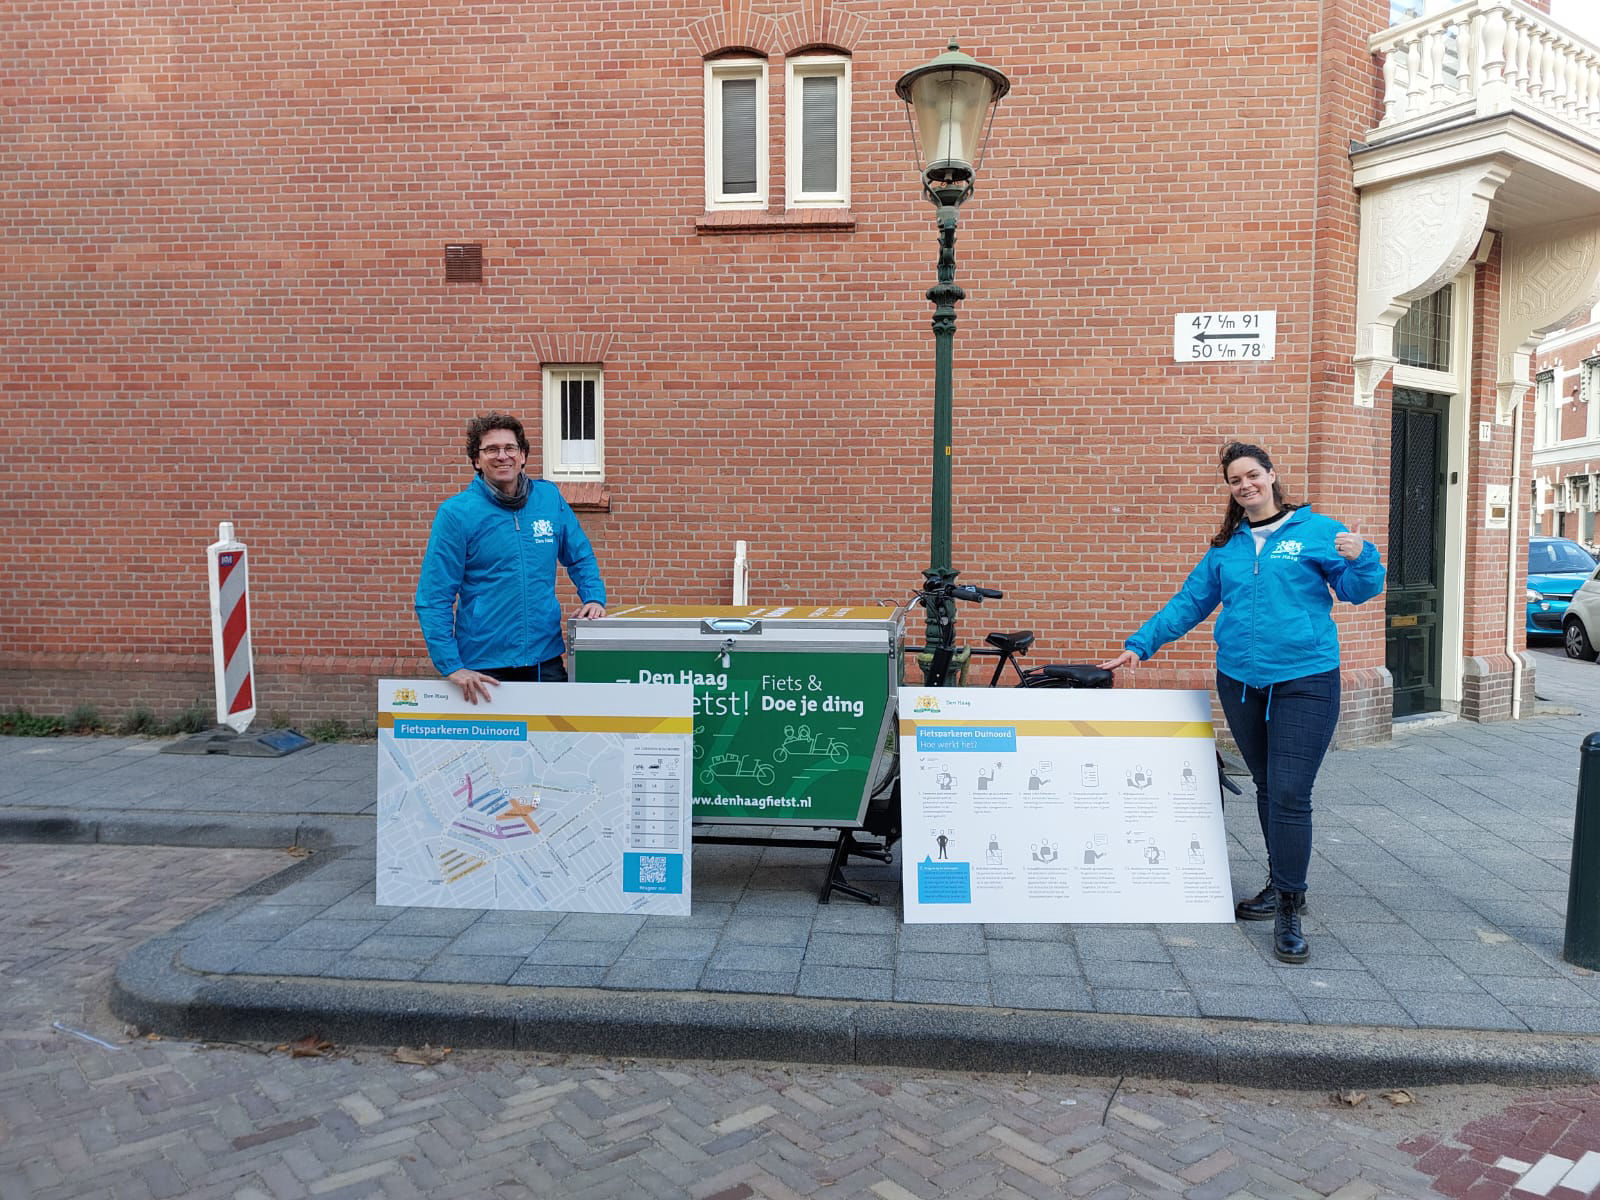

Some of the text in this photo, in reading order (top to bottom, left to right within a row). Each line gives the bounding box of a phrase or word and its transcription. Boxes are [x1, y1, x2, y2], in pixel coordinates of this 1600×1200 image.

[1191, 315, 1213, 330] 47
[1242, 314, 1260, 328] 91
[1191, 344, 1213, 359] 50
[1241, 343, 1261, 358] 78
[639, 669, 728, 691] Den Haag
[762, 674, 823, 692] Fiets &
[692, 690, 750, 716] etst!
[761, 694, 864, 718] Doe je ding
[400, 724, 521, 737] Fietsparkeren Duinoord
[919, 728, 1013, 739] Fietsparkeren Duinoord
[919, 741, 936, 749] Hoe
[937, 741, 960, 749] werkt
[692, 794, 812, 810] ww.denhaagfietst.nl
